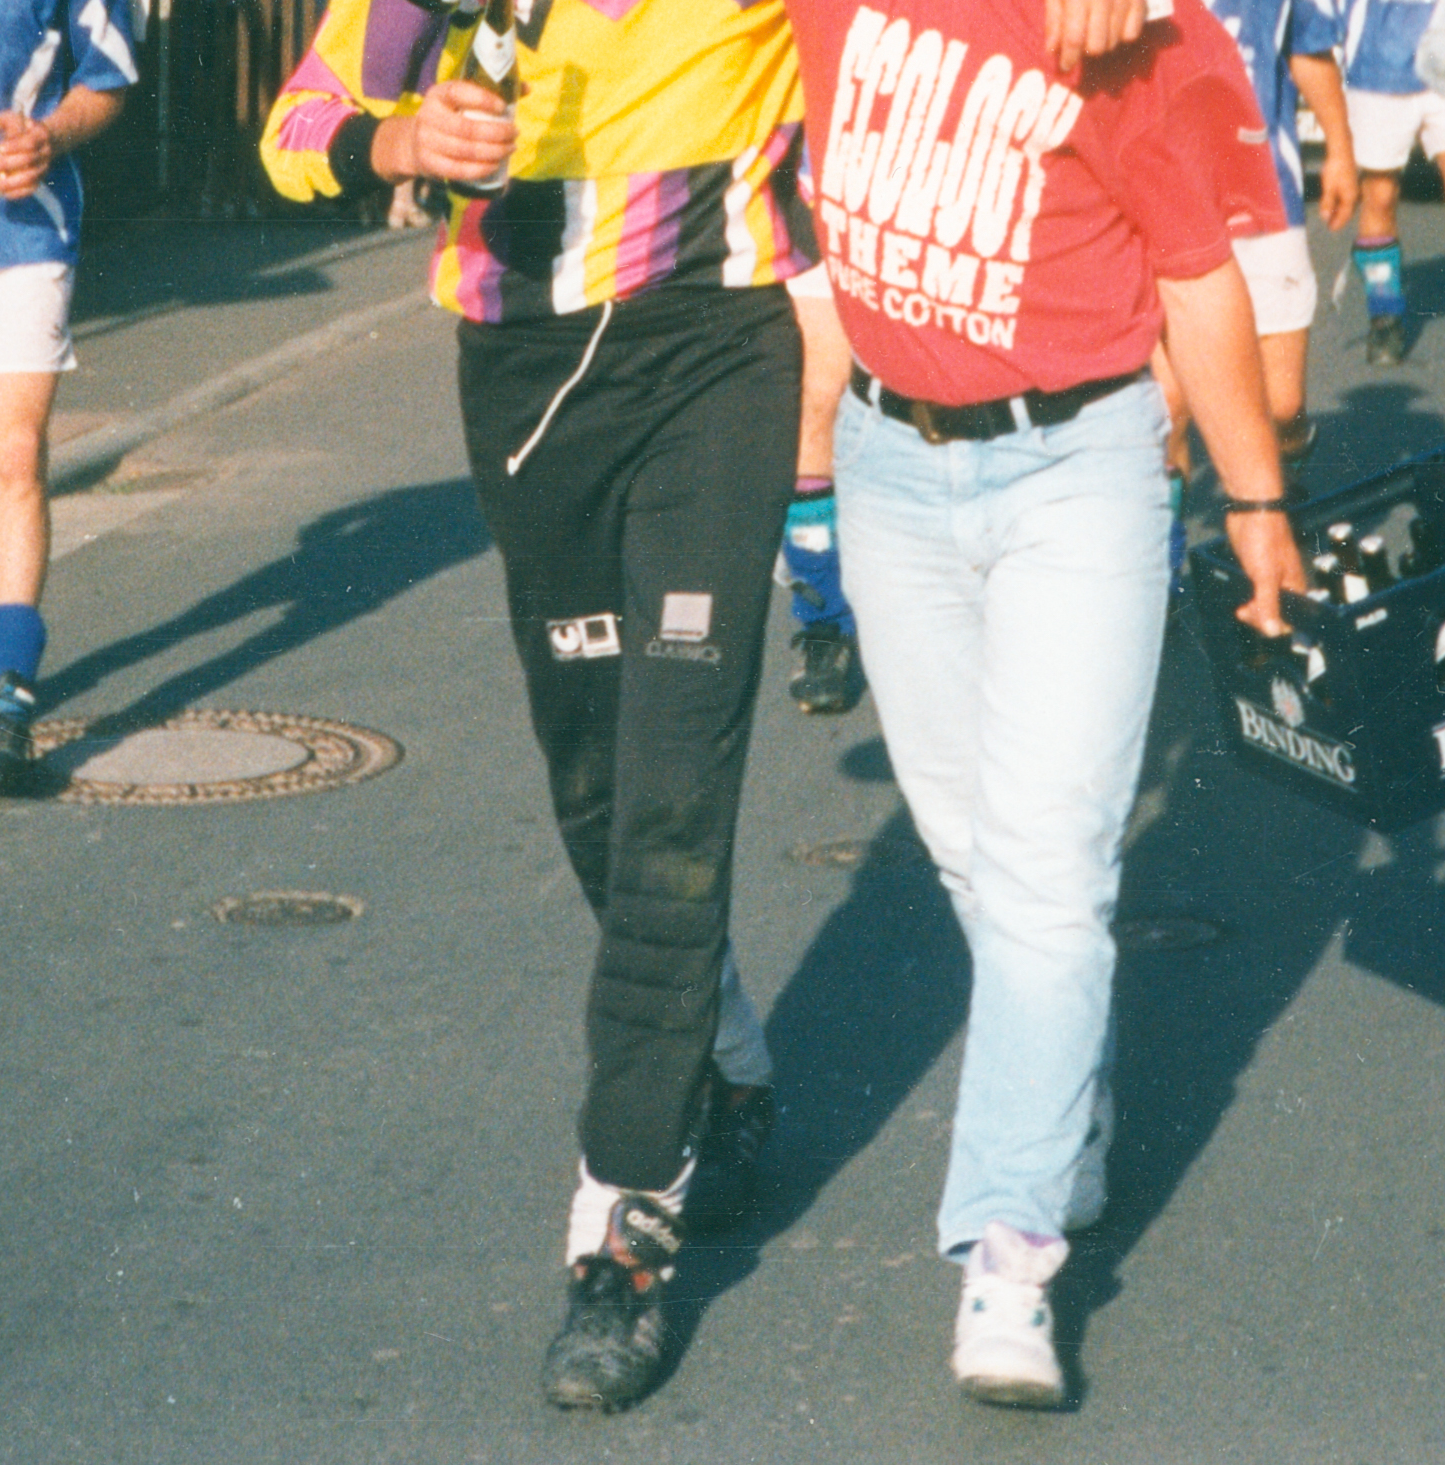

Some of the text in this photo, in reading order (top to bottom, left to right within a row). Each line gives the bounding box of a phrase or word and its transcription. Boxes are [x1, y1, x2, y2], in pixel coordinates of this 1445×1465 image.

[821, 5, 1085, 262] ECOLOGY
[821, 199, 1025, 315] THEME
[882, 287, 1017, 350] COTTON
[1236, 698, 1355, 783] BINDING
